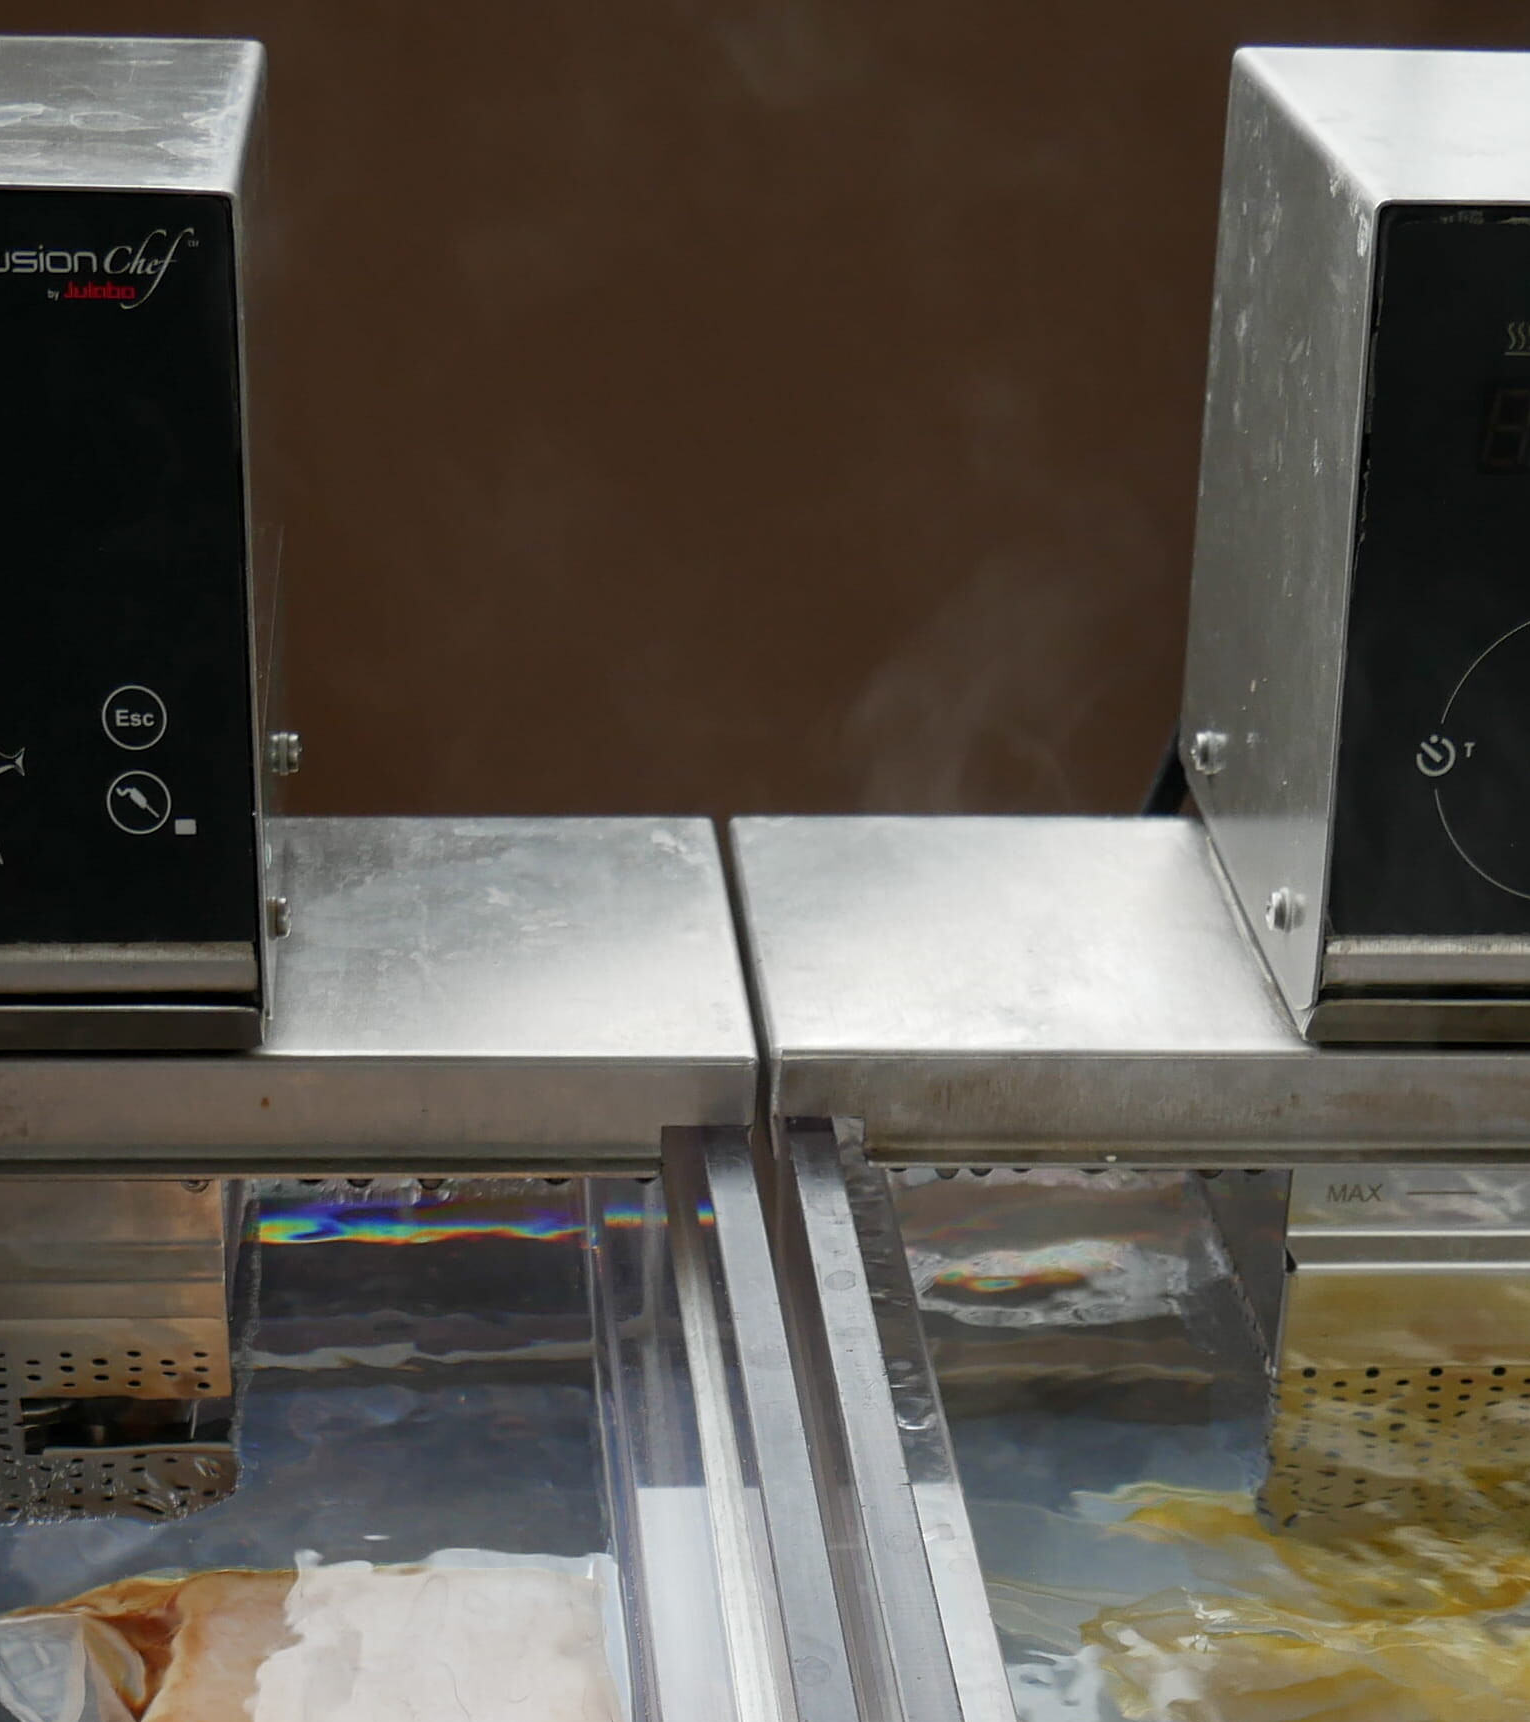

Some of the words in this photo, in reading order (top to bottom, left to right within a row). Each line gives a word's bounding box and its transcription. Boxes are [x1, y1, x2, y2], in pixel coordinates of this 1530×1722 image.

[103, 227, 194, 310] Chef
[47, 288, 60, 301] by
[63, 281, 137, 300] Julabo
[114, 708, 155, 729] Esc
[1326, 1183, 1384, 1203] MAX
